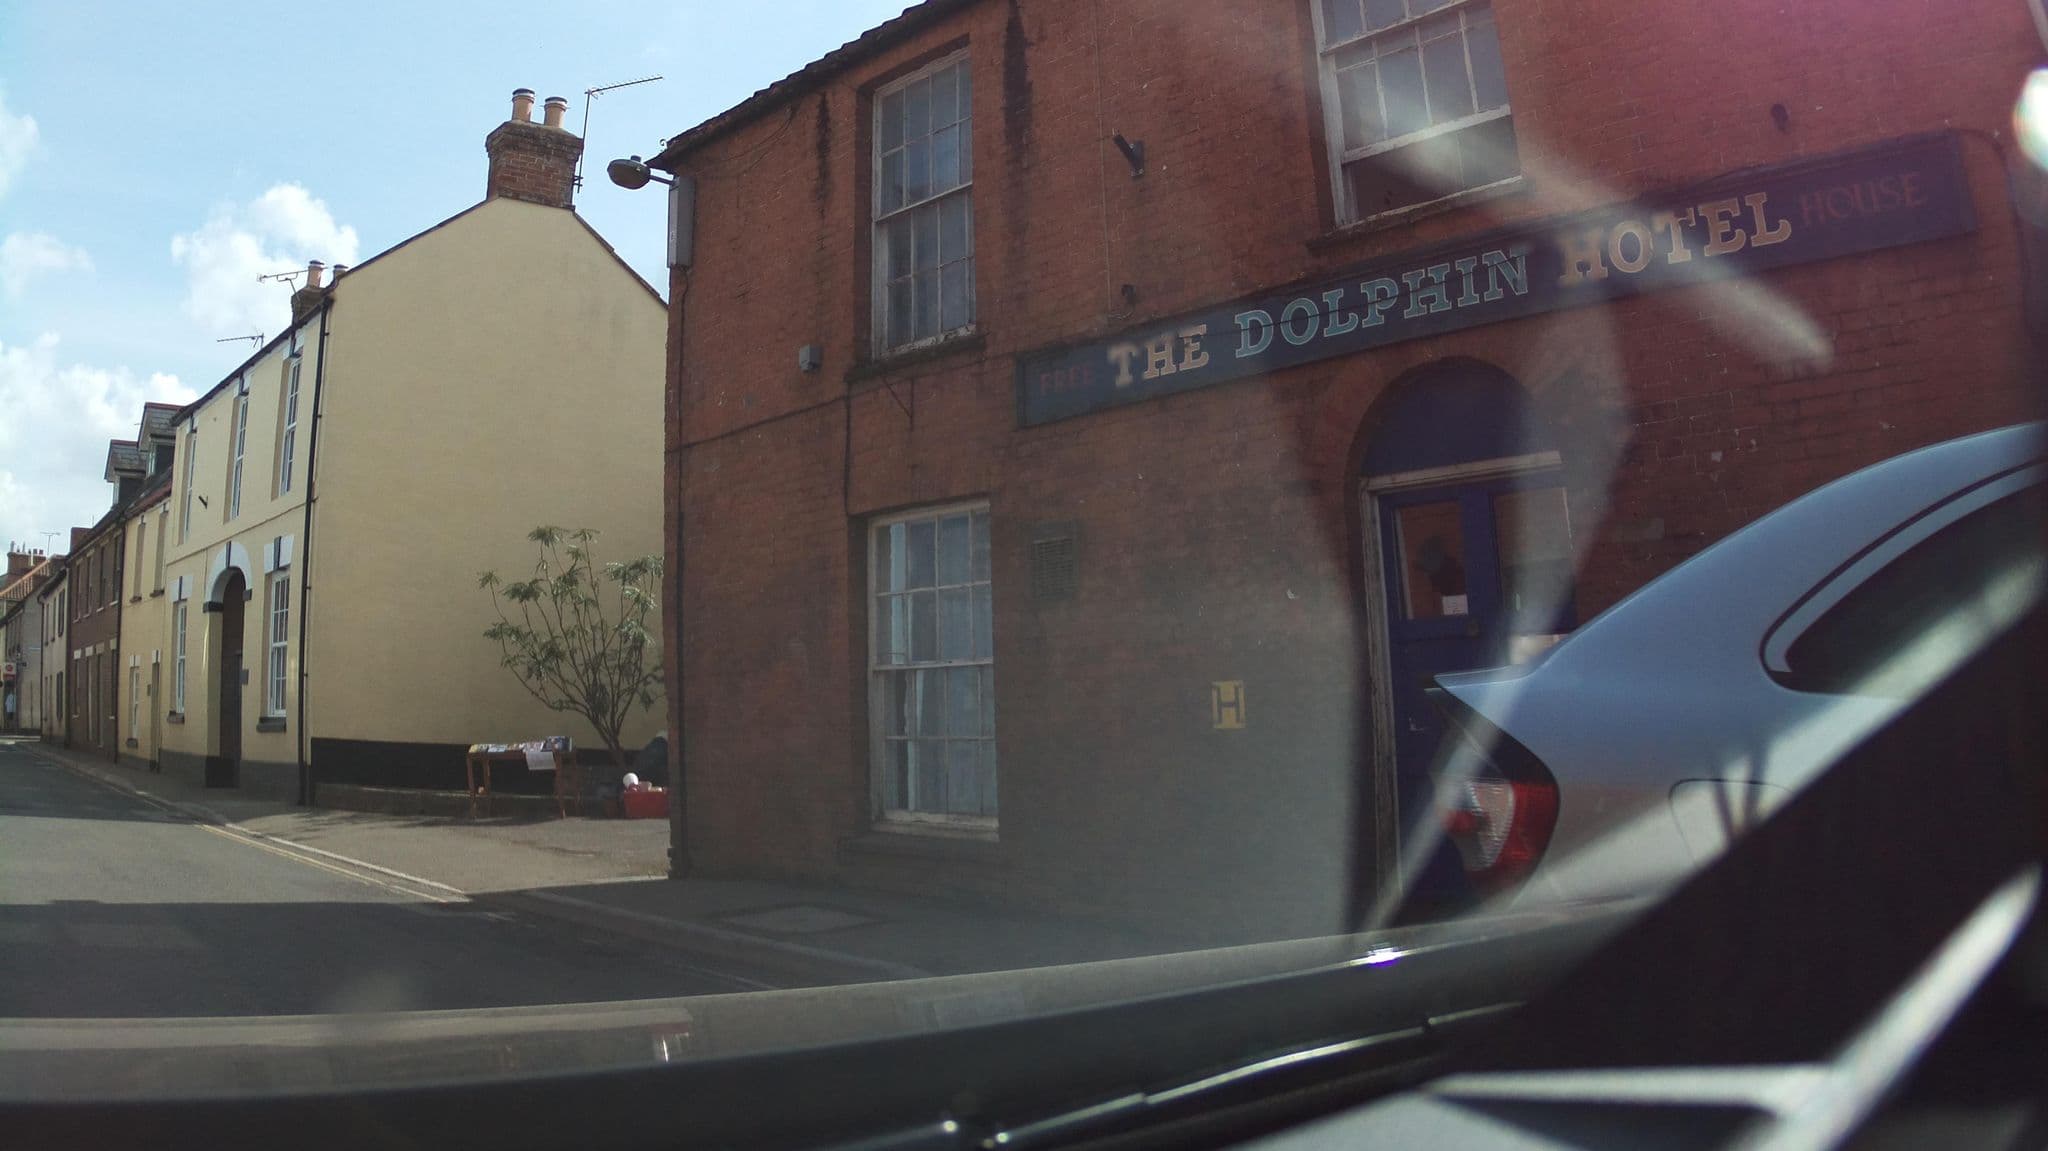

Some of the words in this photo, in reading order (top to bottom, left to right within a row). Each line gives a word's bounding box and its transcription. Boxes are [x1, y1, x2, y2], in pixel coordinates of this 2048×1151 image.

[1107, 322, 1210, 388] THE
[1233, 245, 1531, 360] DOLPHIN
[1558, 191, 1793, 285] HOTEL
[1800, 172, 1926, 226] HOUSE
[1215, 685, 1241, 725] H
